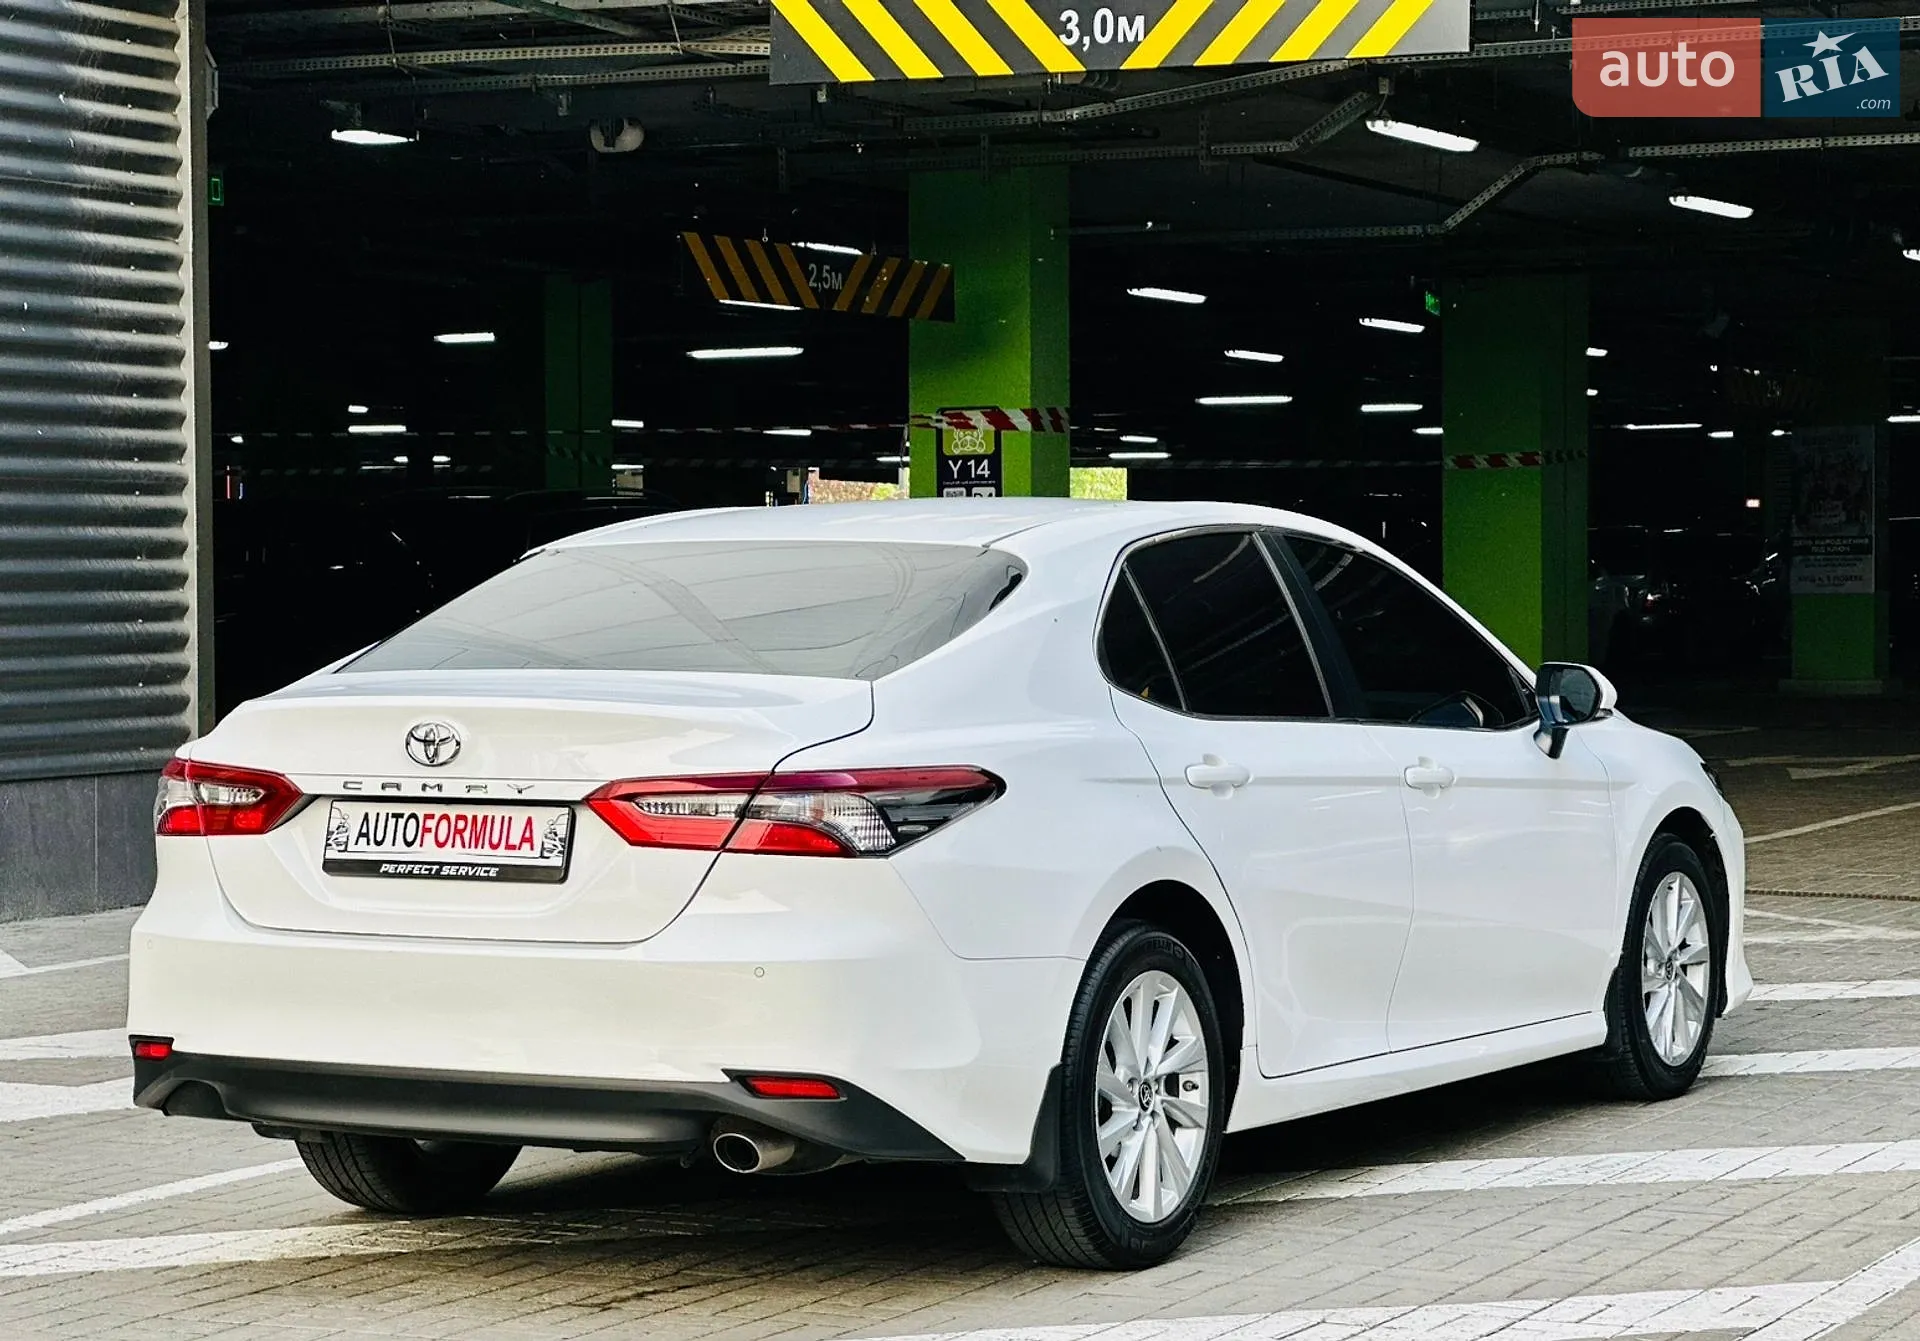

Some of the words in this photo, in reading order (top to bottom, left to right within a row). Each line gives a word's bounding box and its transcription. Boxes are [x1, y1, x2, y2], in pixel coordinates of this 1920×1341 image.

[948, 460, 962, 479] Y
[967, 459, 991, 478] 14
[342, 780, 535, 795] CAMRY
[354, 811, 535, 851] AUTOFORMULA
[380, 863, 440, 875] PERFECT
[440, 865, 499, 877] SERVICE
